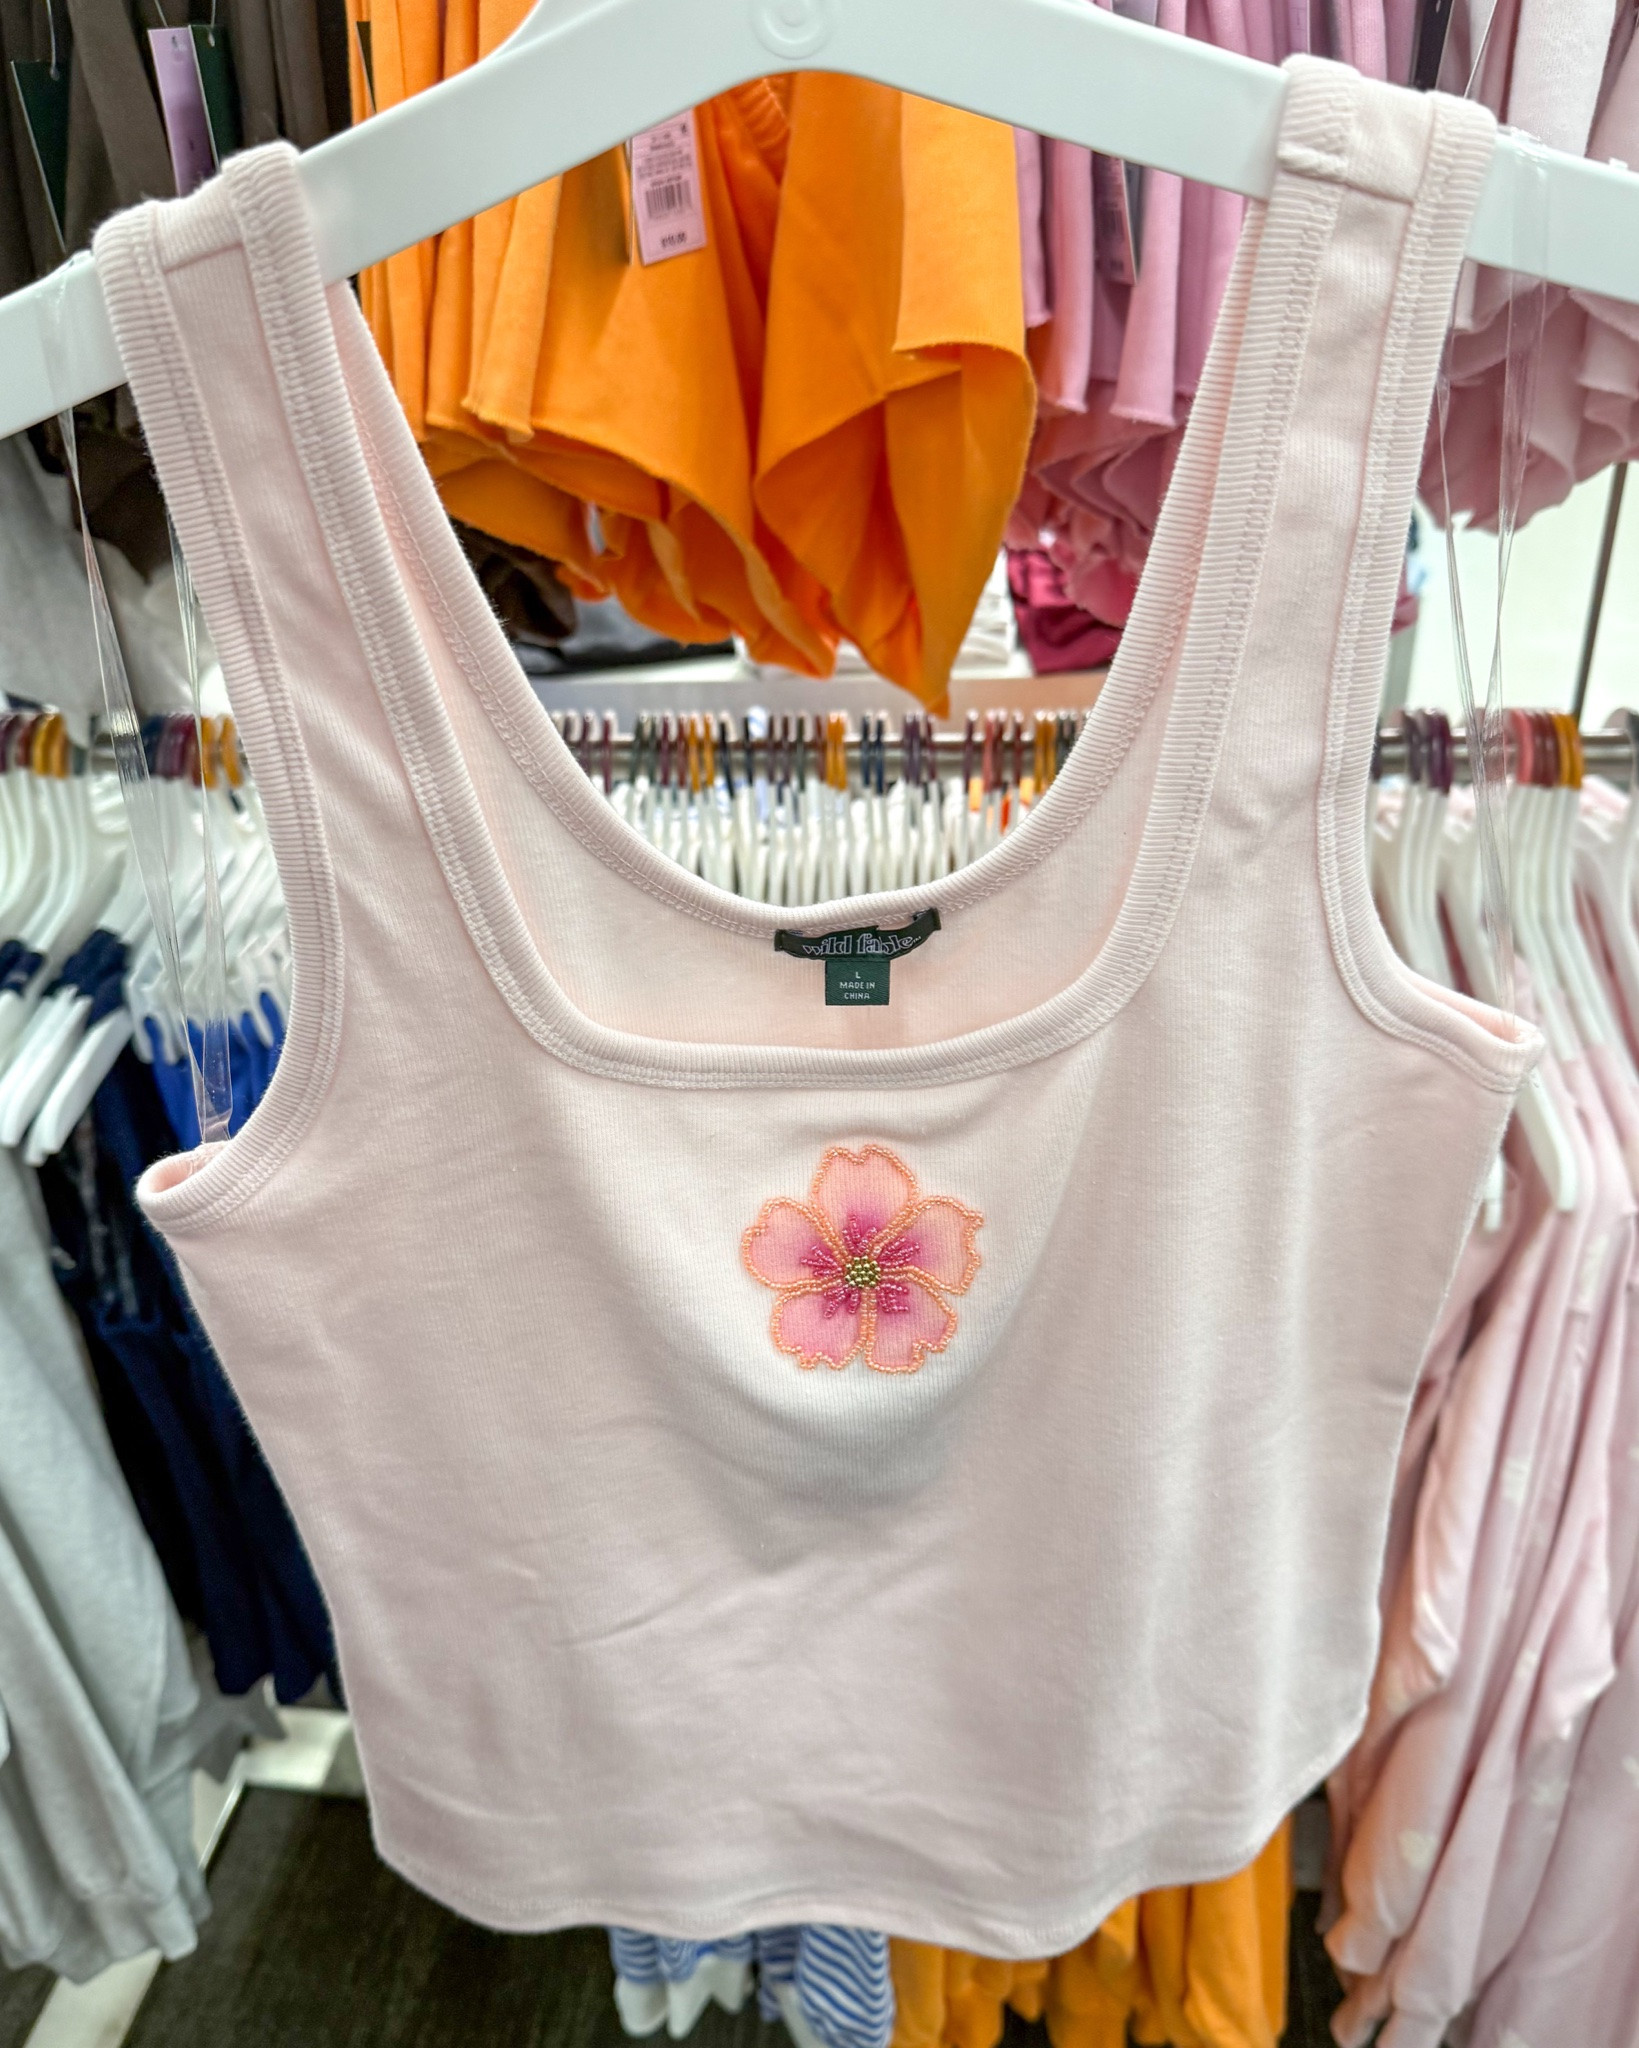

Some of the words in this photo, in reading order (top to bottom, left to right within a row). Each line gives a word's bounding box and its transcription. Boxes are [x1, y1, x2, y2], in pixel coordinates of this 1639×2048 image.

[802, 935, 853, 956] wild
[855, 971, 861, 979] L
[839, 981, 865, 990] MADE
[866, 981, 876, 990] IN
[844, 992, 870, 1000] CHINA
